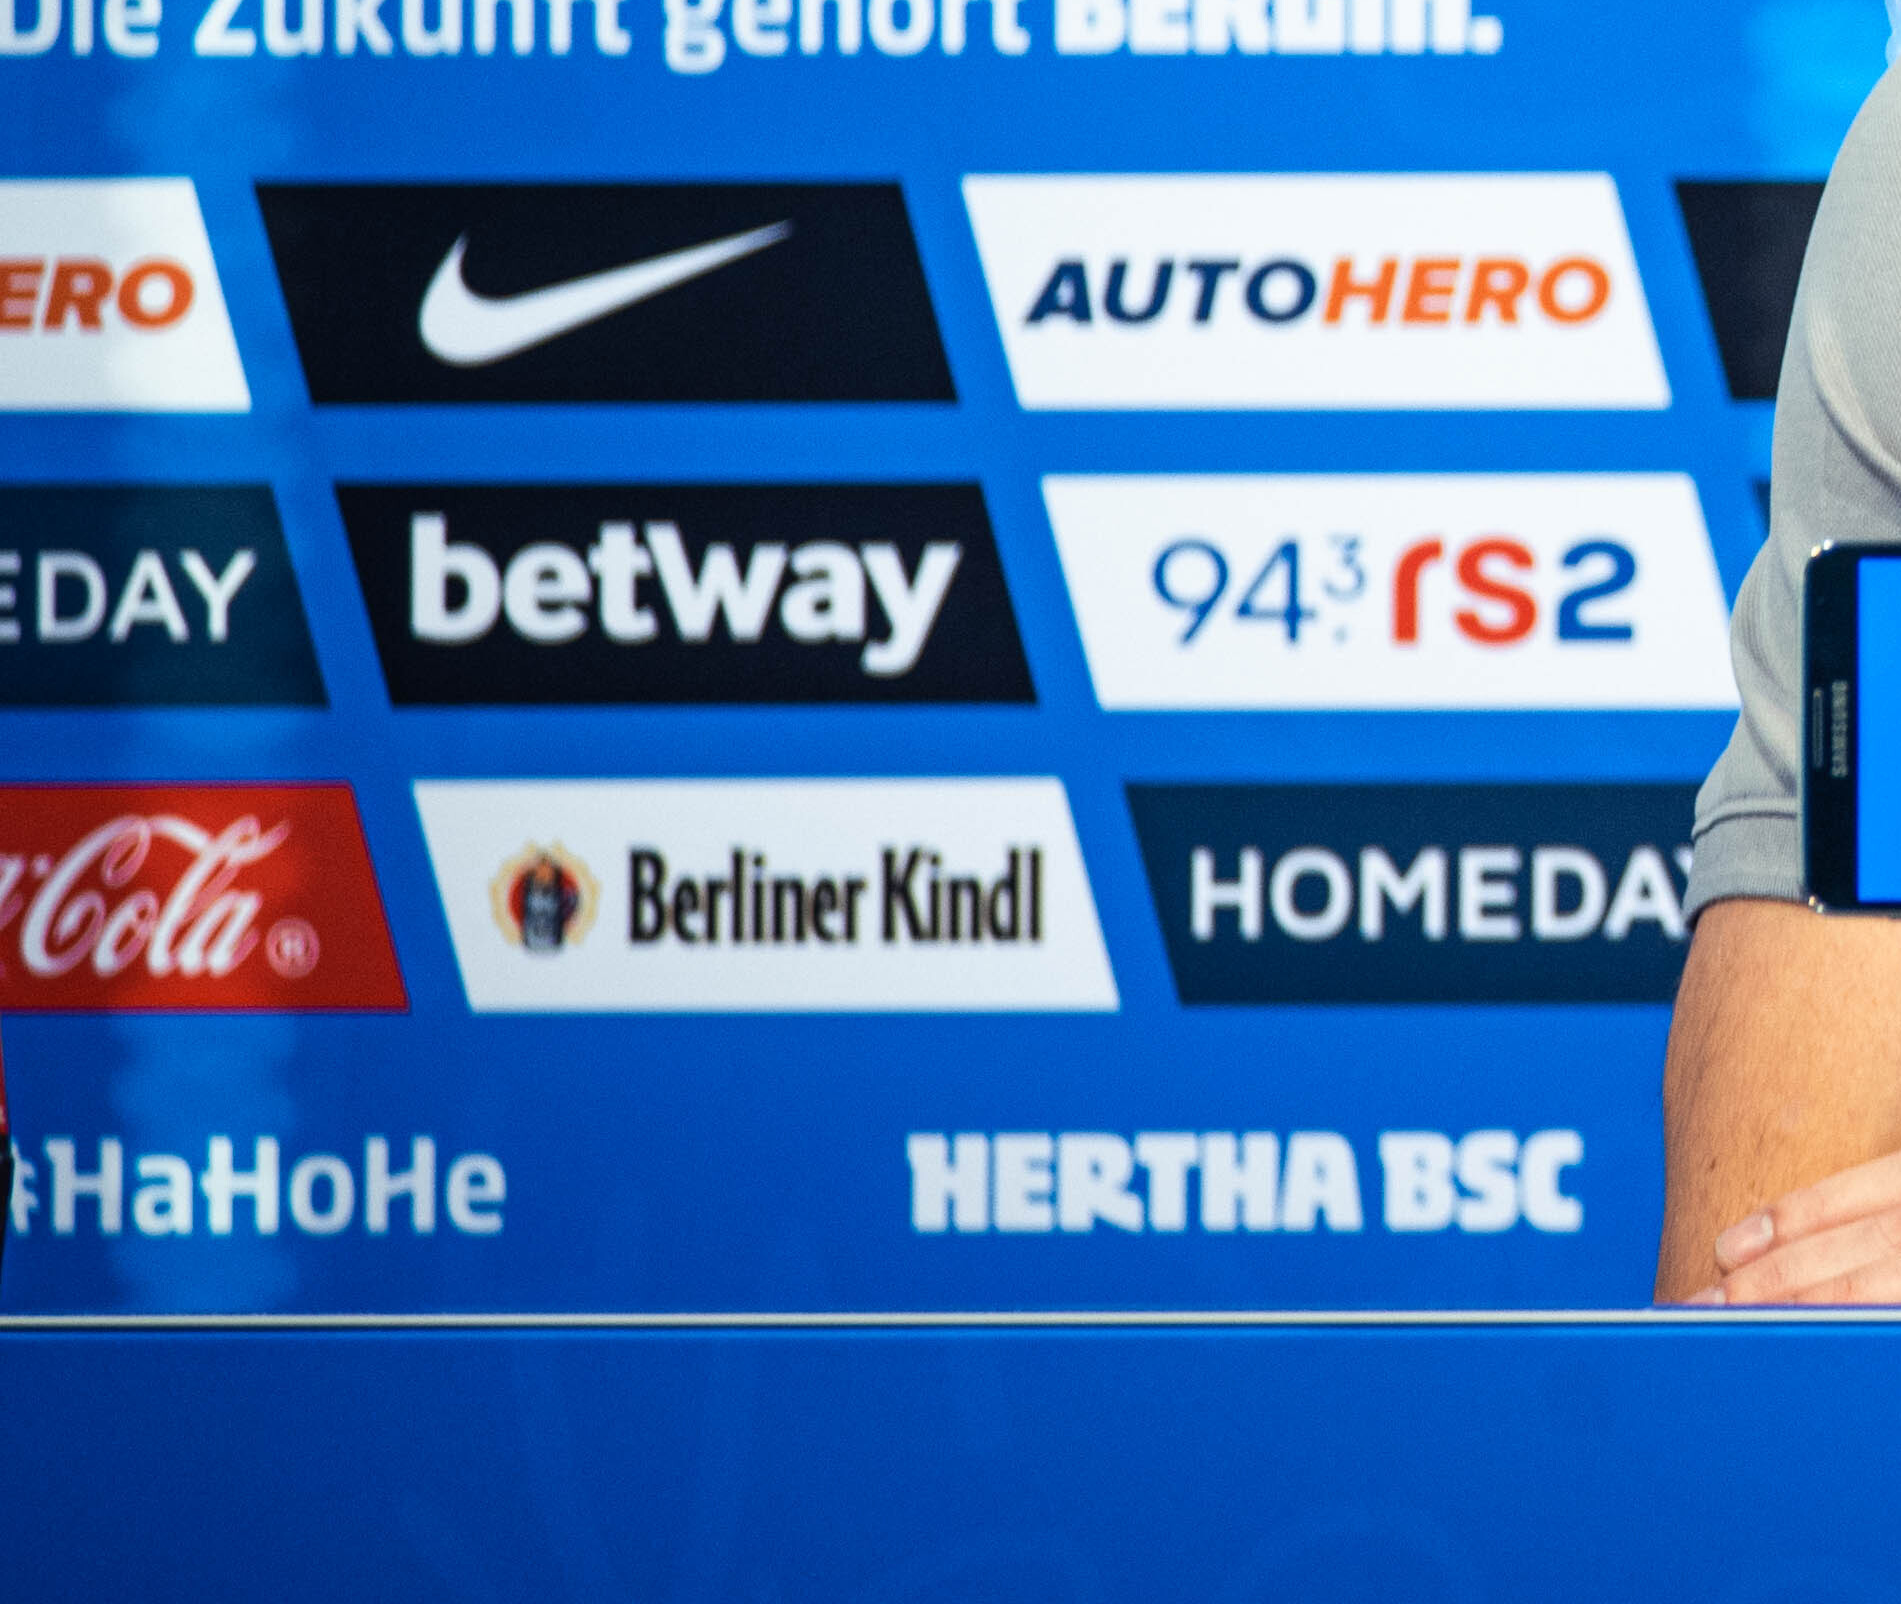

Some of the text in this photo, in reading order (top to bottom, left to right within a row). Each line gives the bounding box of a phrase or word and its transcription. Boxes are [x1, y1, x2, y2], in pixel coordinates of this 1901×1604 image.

[1024, 257, 1610, 327] AUTOHERO
[410, 512, 962, 677] betway
[1392, 536, 1638, 646] rs2
[626, 845, 1045, 947] Berliner Kindl
[1189, 844, 1693, 943] HOMEDA
[908, 1130, 1584, 1235] HERTHA BSC
